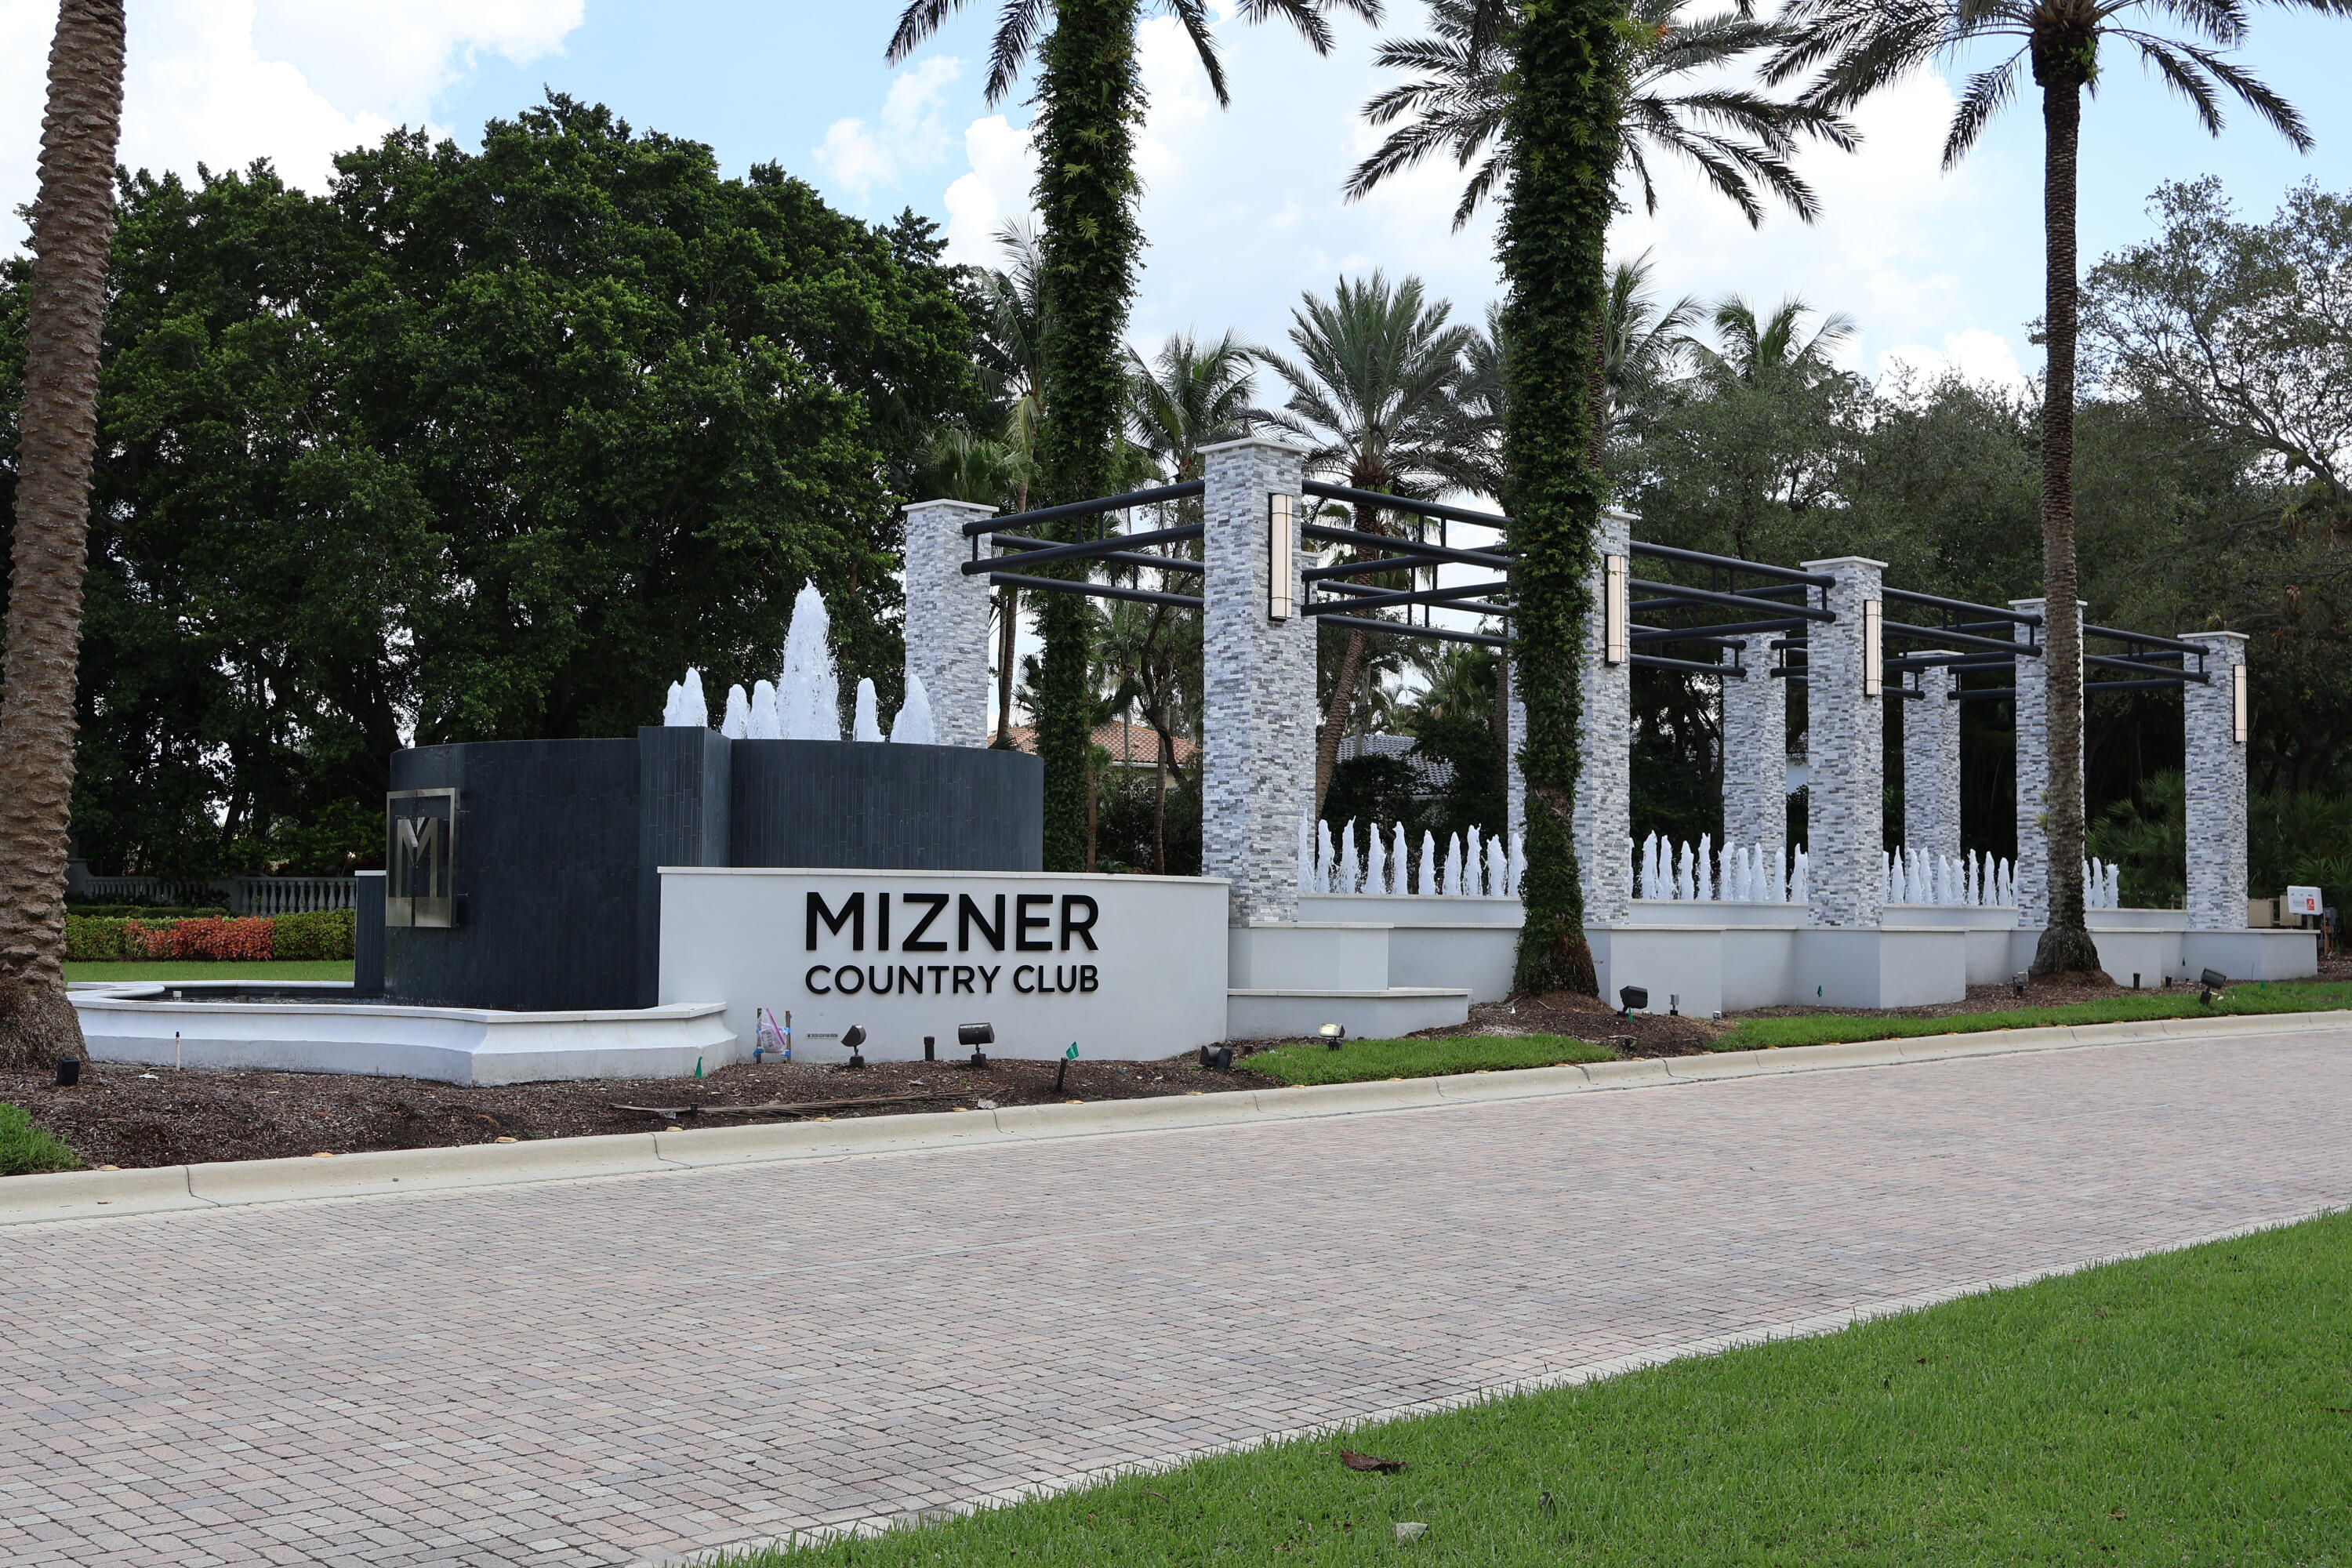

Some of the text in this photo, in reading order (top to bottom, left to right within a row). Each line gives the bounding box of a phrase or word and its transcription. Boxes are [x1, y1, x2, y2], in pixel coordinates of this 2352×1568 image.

[804, 891, 1100, 953] MIZNER
[805, 964, 1100, 996] COUNTRY CLUB
